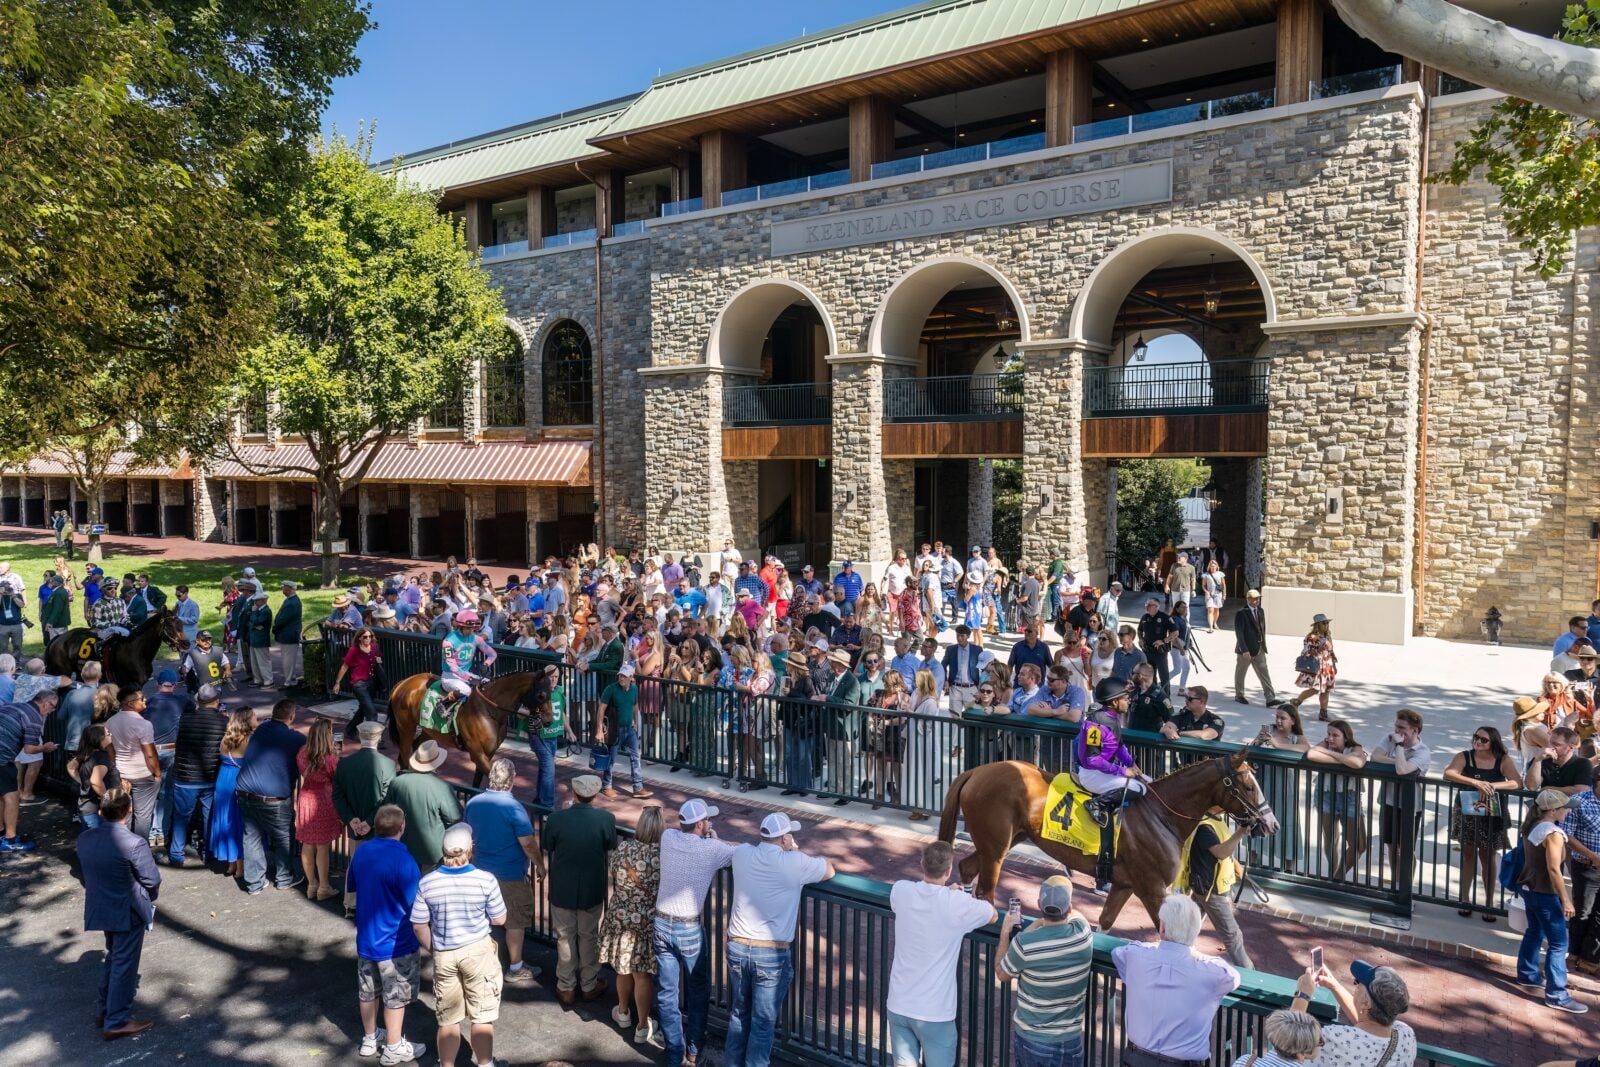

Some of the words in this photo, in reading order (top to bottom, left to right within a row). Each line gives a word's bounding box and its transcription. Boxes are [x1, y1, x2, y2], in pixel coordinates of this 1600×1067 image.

[805, 208, 934, 244] KEENELAND
[942, 197, 1005, 224] RACE
[1015, 179, 1121, 213] COURSE
[79, 637, 96, 660] 6
[444, 647, 452, 658] 5
[208, 662, 220, 678] 6
[551, 701, 561, 721] 5
[1089, 729, 1098, 744] 4
[1050, 791, 1074, 832] 4
